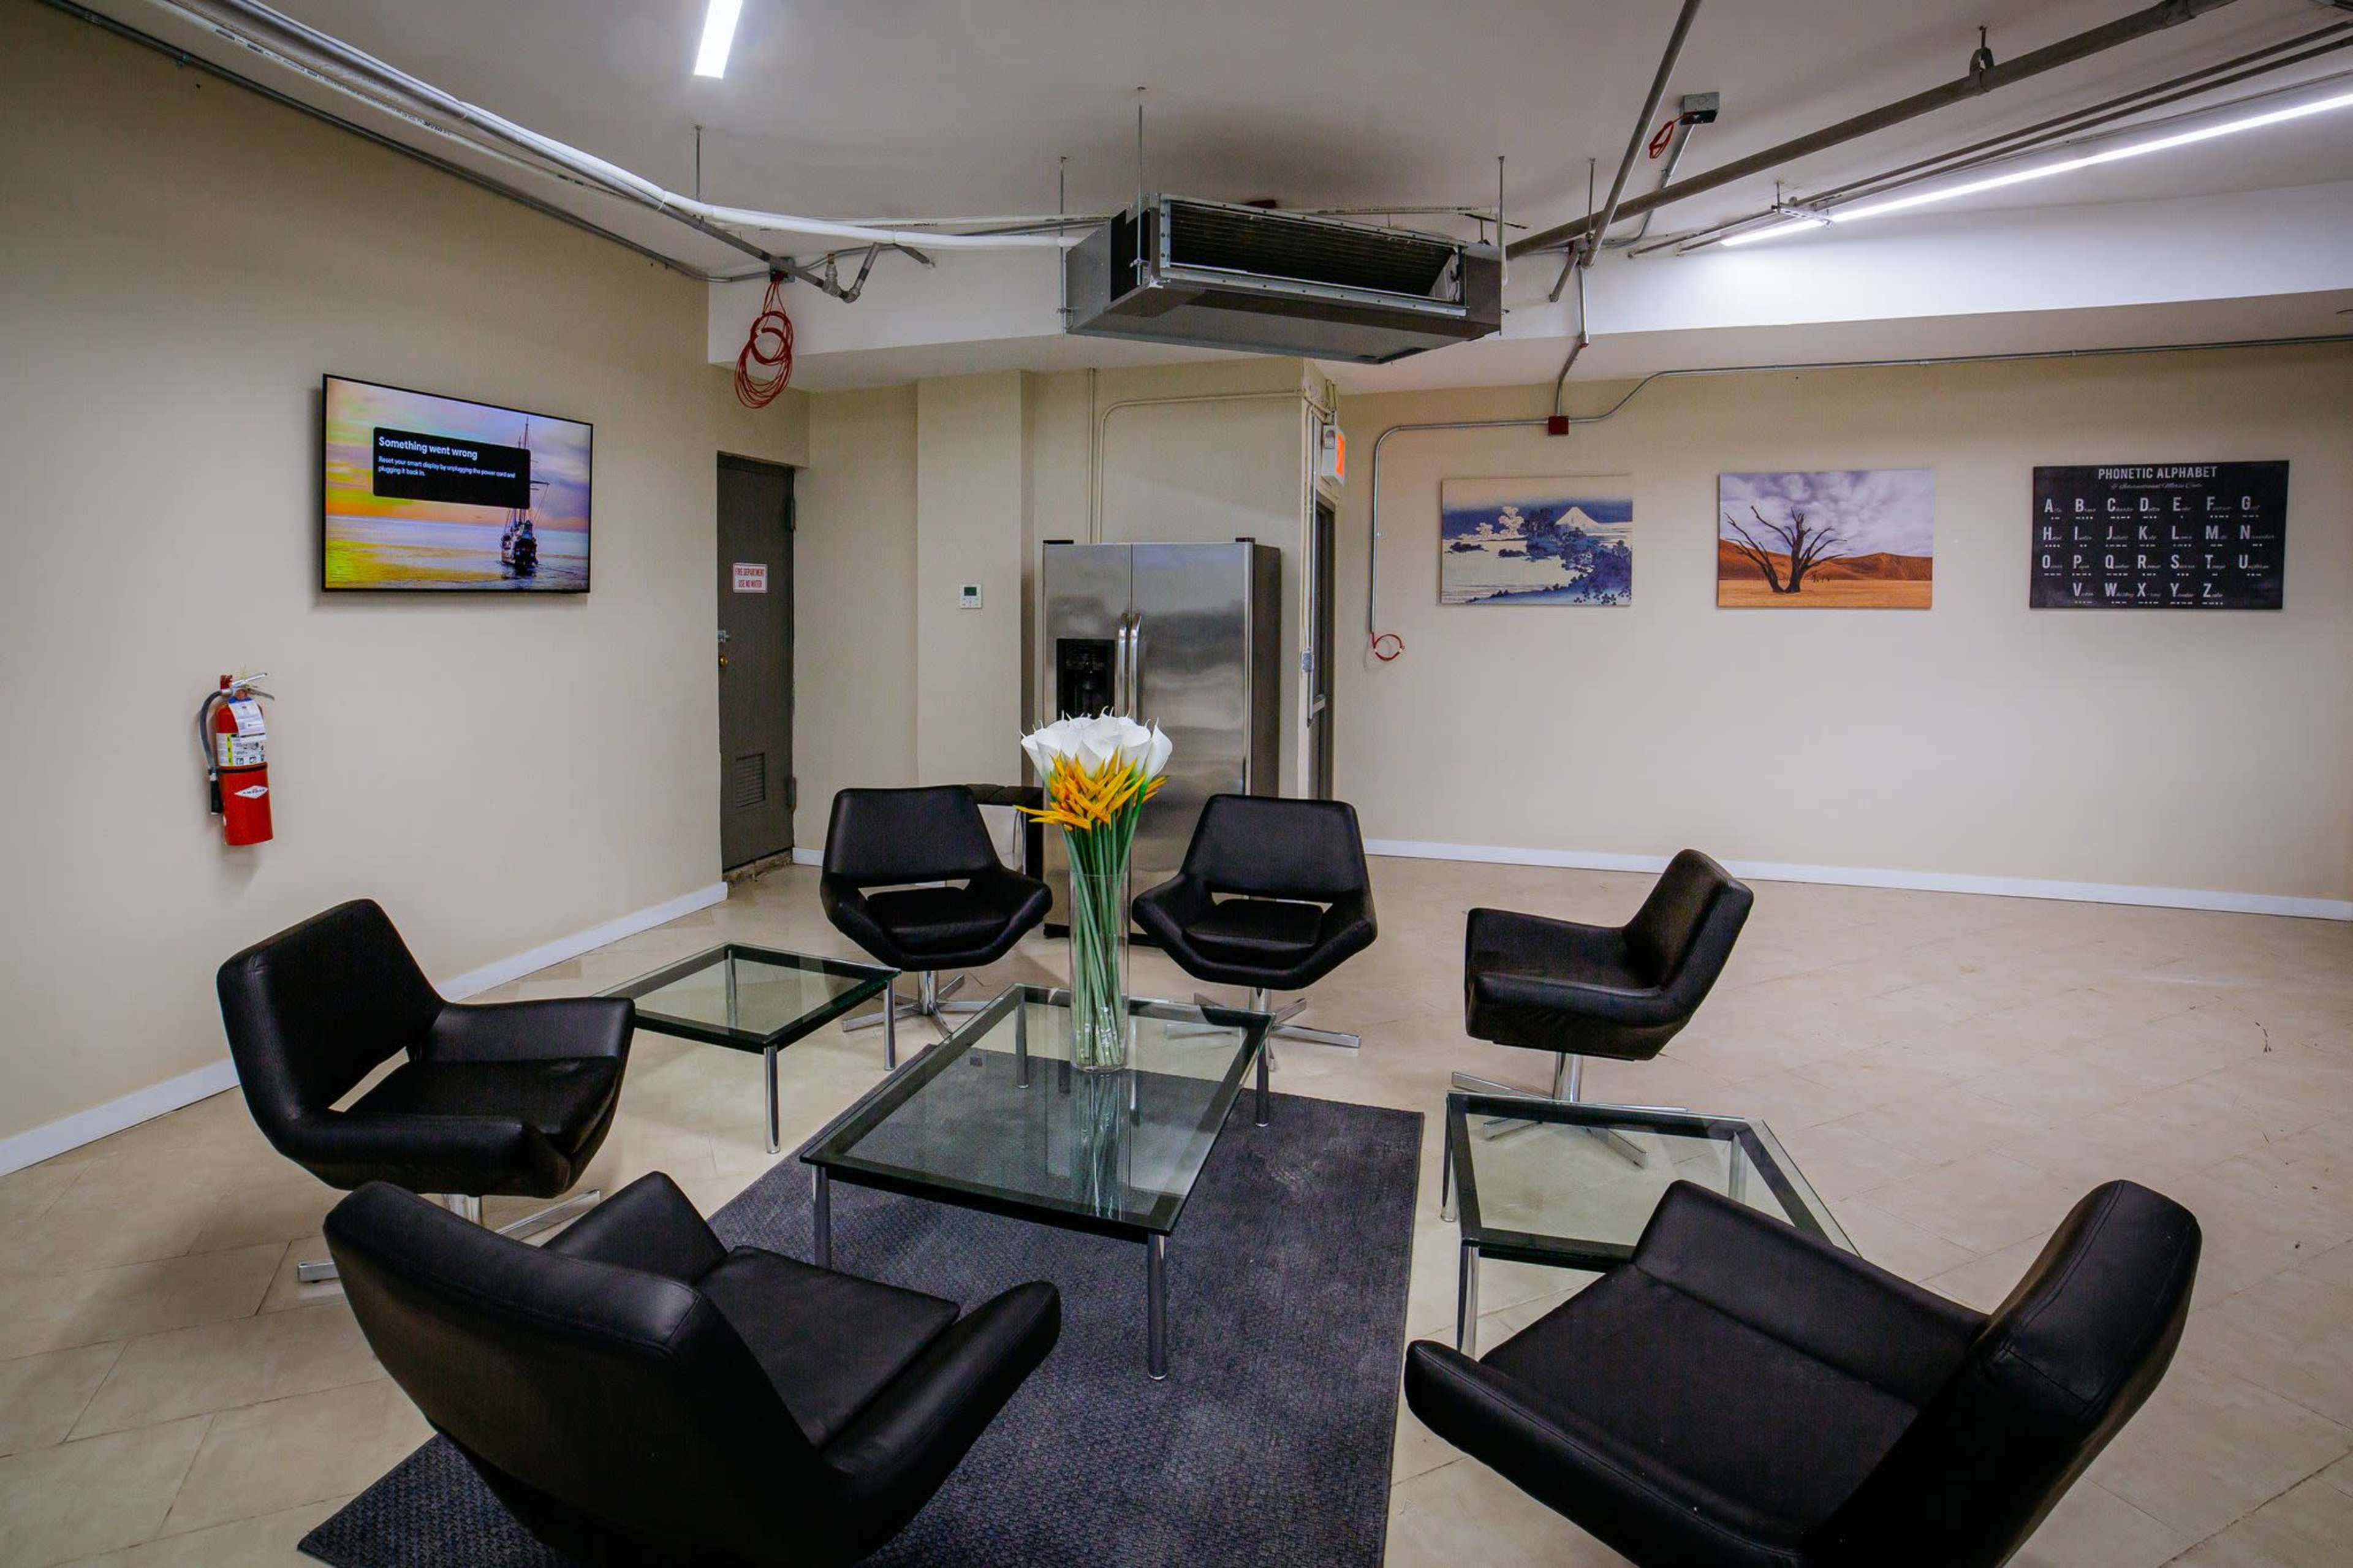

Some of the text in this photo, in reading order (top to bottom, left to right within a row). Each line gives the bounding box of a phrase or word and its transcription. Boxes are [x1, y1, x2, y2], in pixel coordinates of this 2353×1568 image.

[379, 436, 478, 461] Something went wrong
[2098, 466, 2218, 480] PHONETIC ALPHABET
